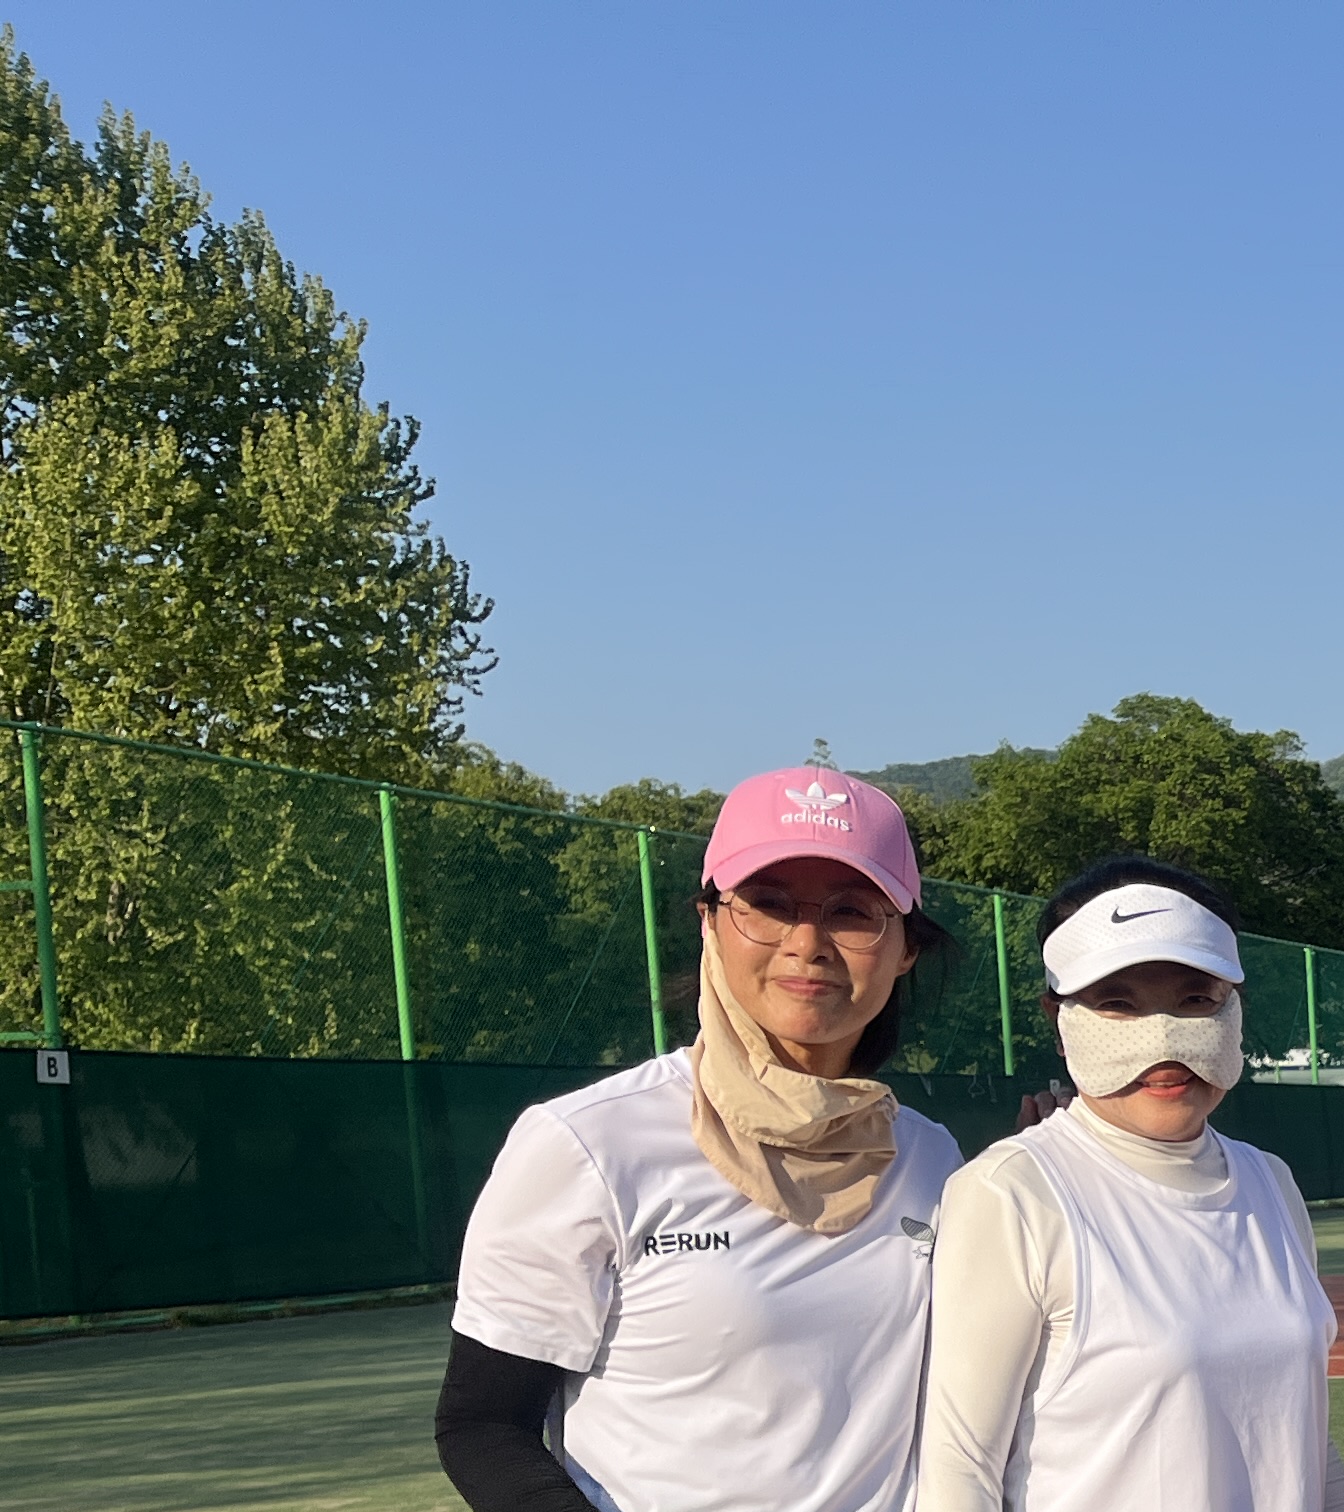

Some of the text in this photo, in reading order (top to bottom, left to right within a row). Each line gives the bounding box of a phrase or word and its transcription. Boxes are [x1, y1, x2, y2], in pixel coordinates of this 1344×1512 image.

[781, 809, 850, 831] adidas
[47, 1056, 58, 1078] B
[644, 1230, 730, 1257] RERUN
